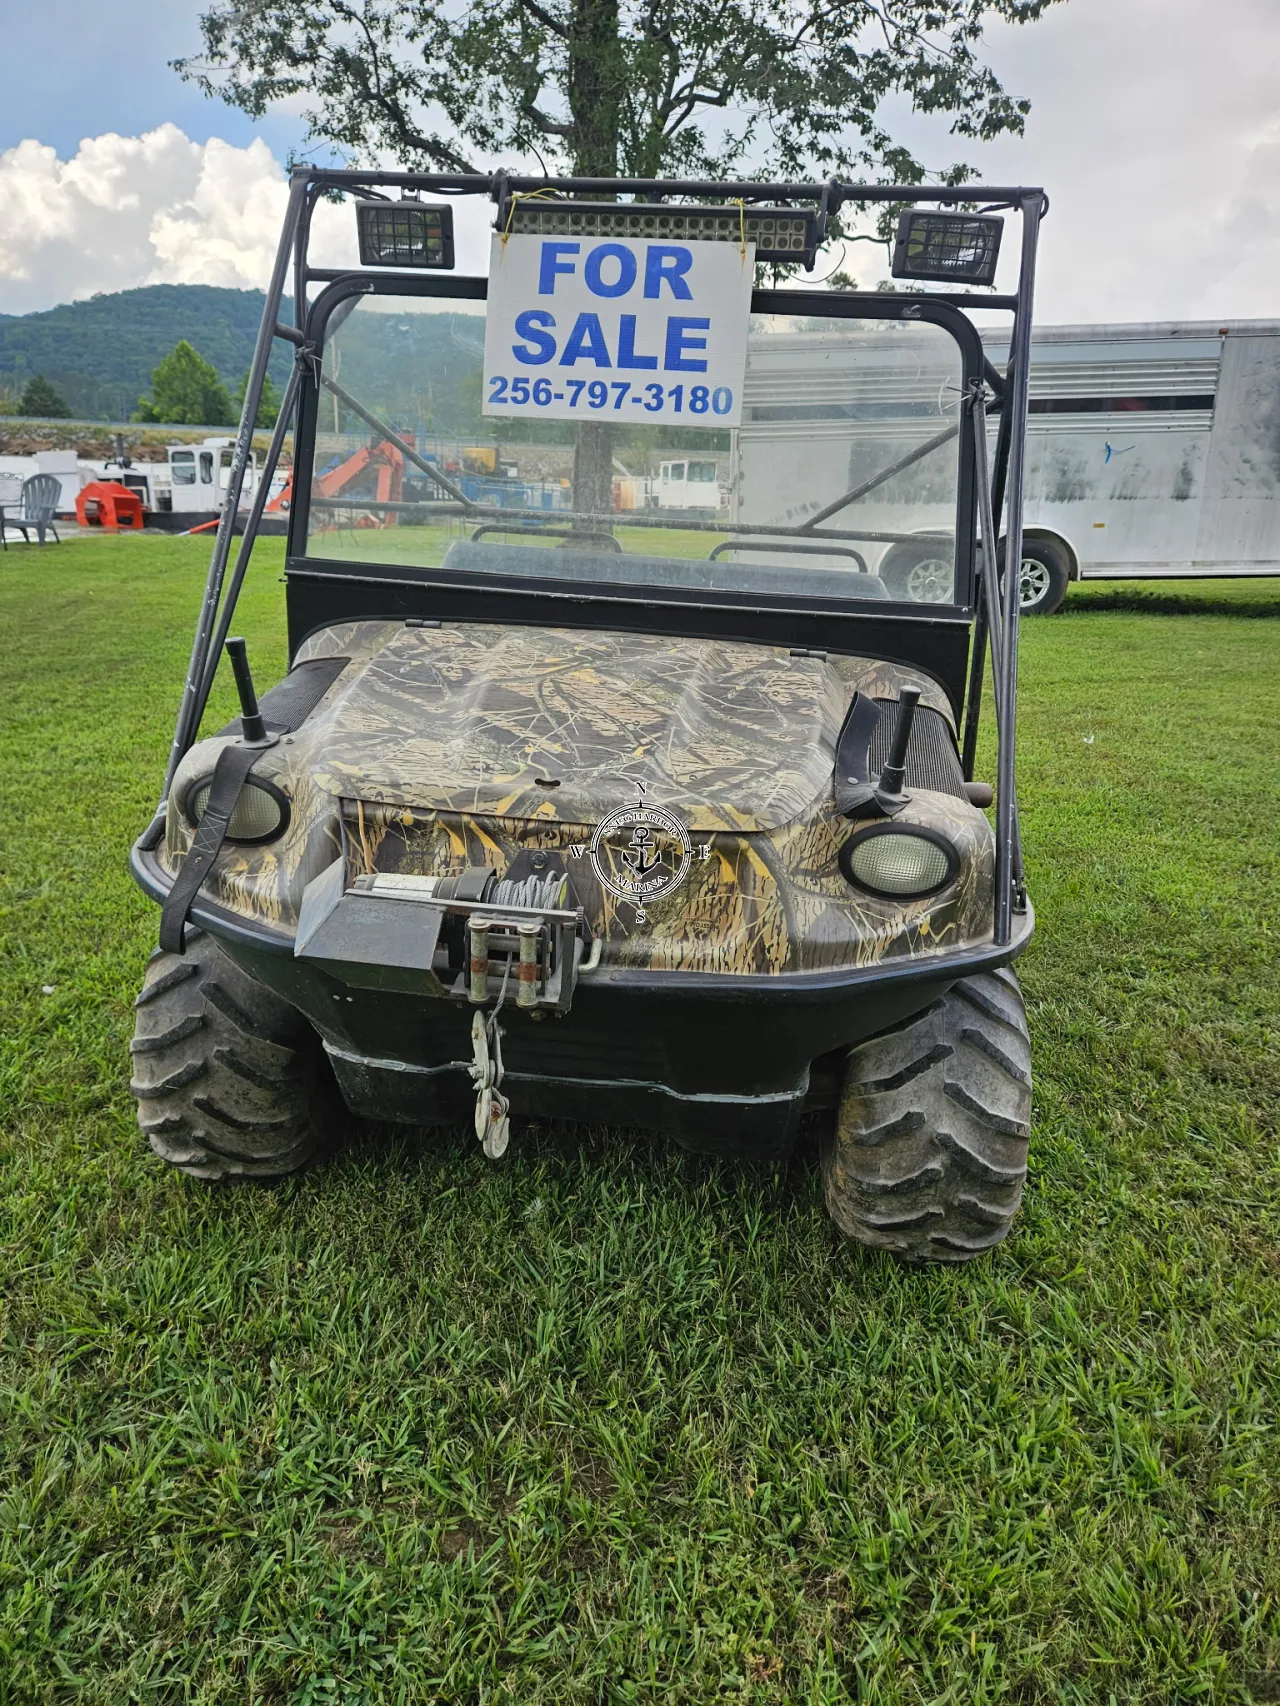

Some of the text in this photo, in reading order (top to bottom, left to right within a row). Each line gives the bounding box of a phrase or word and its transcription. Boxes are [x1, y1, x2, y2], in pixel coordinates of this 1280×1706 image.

[538, 242, 694, 300] FOR
[511, 310, 711, 372] SALE
[488, 375, 733, 415] 256-797-3180
